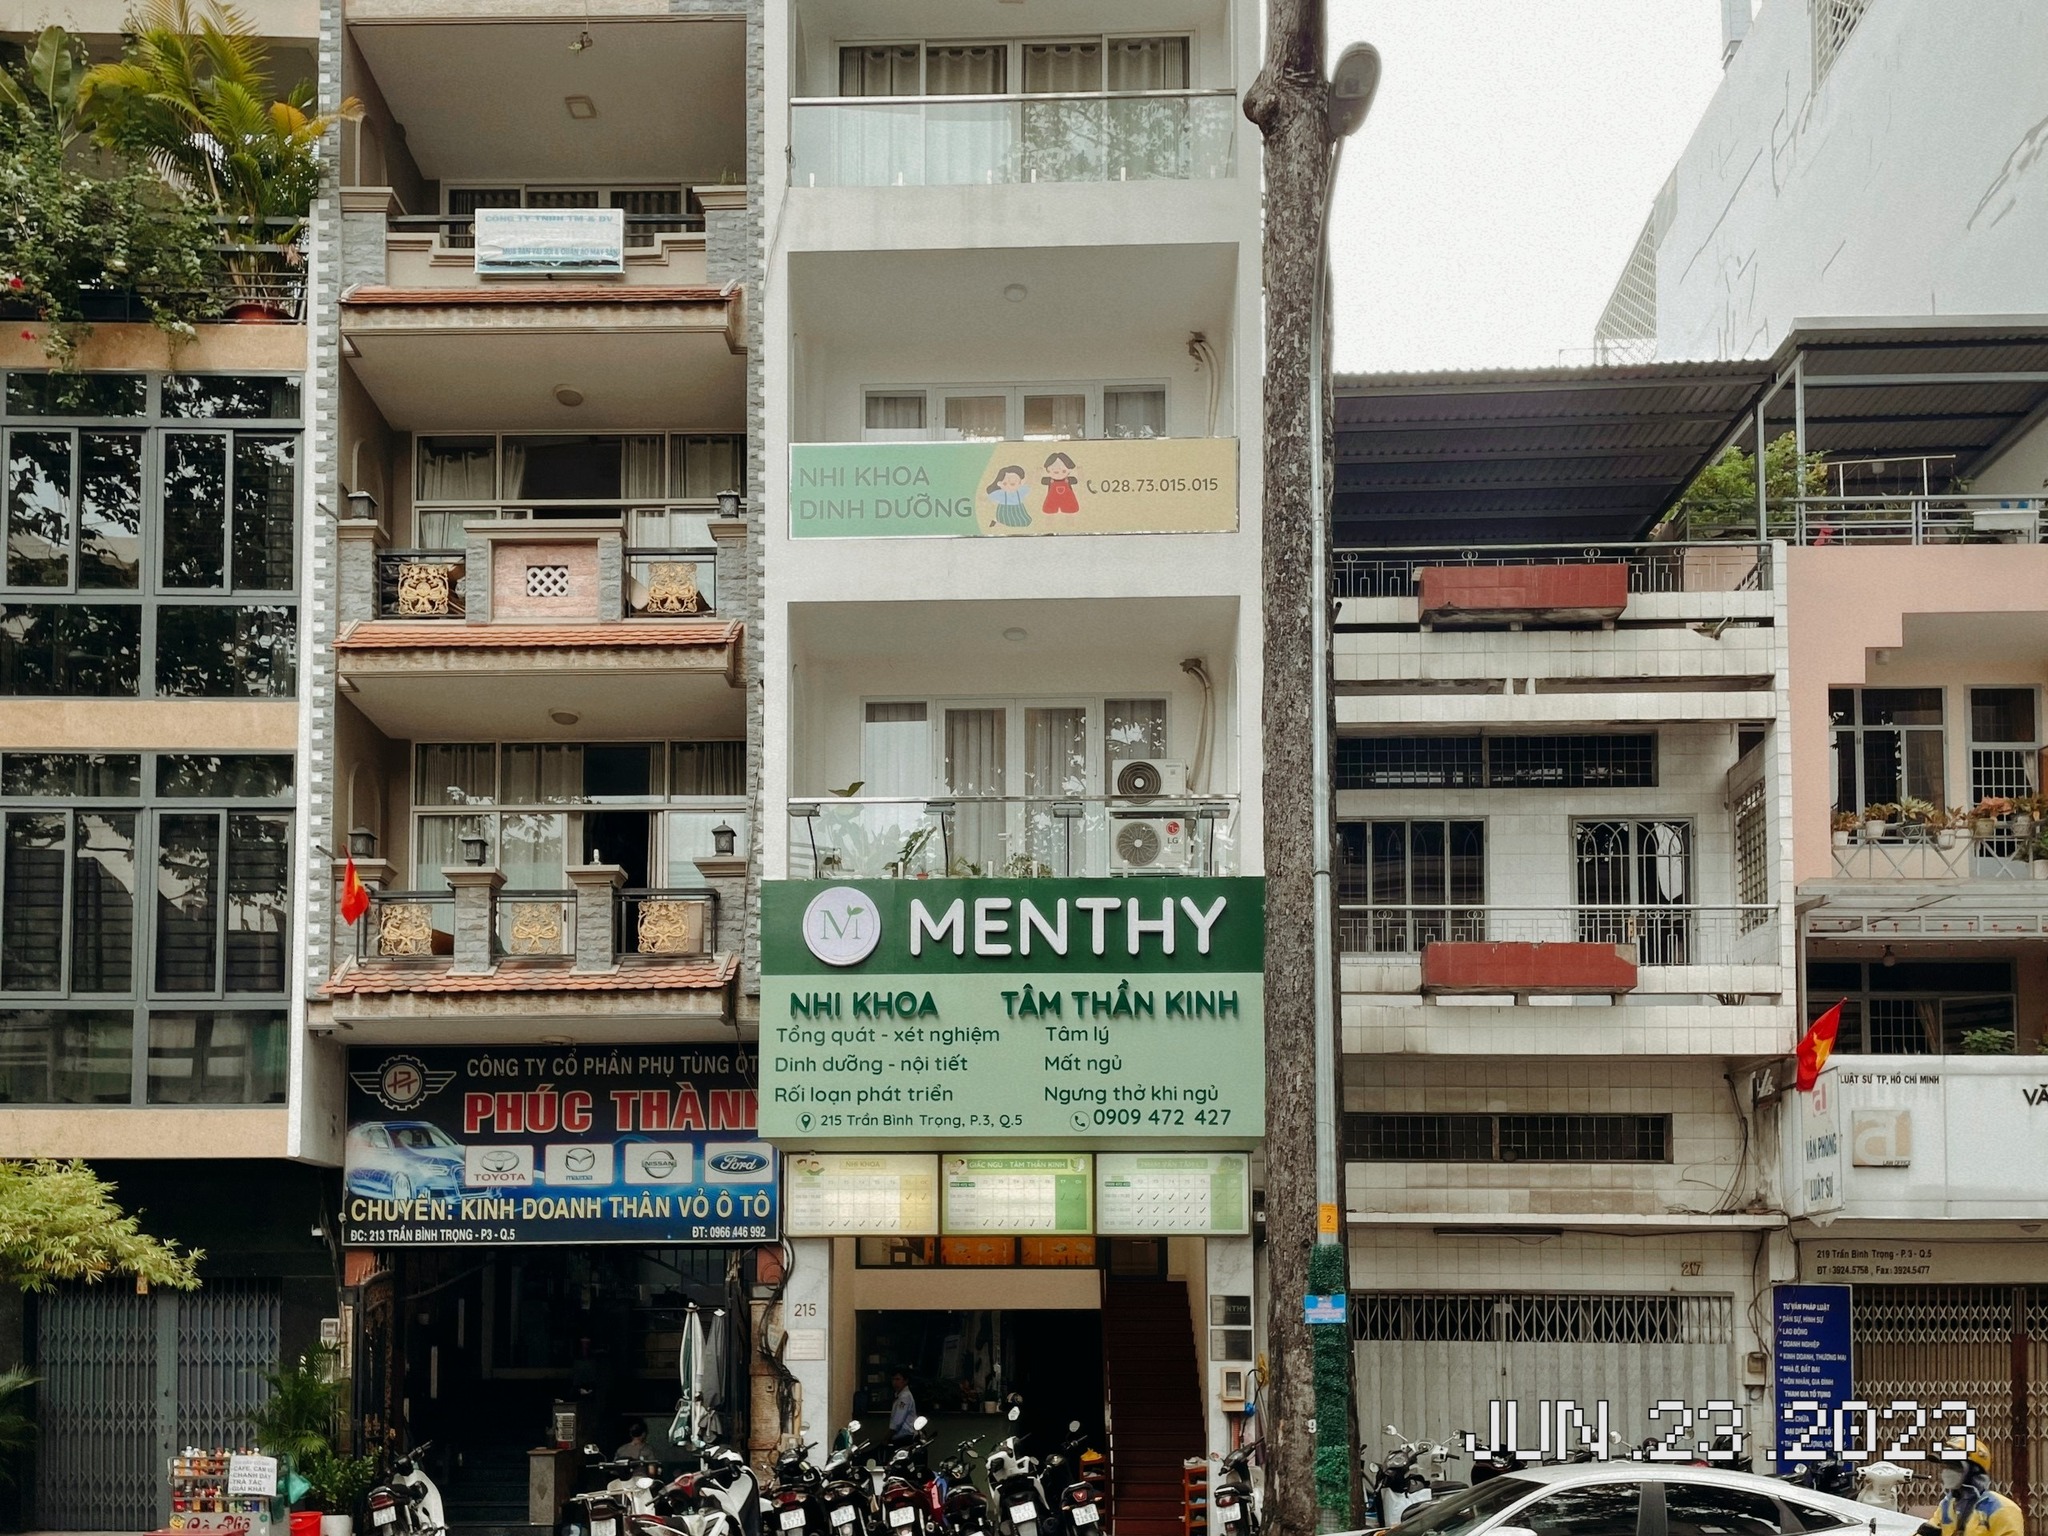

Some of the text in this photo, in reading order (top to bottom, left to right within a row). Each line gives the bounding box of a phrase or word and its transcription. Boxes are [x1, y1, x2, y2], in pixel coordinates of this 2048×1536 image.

[800, 466, 930, 488] NHI KHOA
[1100, 478, 1218, 494] 028.73.015.015
[800, 494, 973, 520] DINH DƯỠNG
[1167, 837, 1179, 845] LG
[909, 896, 1228, 956] MENTHY
[790, 991, 939, 1018] NHI KHOA
[1000, 978, 1238, 1017] TÂM THẦN KINH
[776, 1025, 1000, 1046] Tổng quát xét nghiệm
[1046, 1025, 1110, 1045] Tâm lý
[466, 1054, 519, 1077] CÔNG
[524, 1057, 547, 1077] TY
[552, 1047, 578, 1077] CỔ
[583, 1048, 632, 1076] PHẦN
[638, 1055, 676, 1078] PHỤ
[680, 1051, 730, 1074] TÙNG
[775, 1054, 968, 1075] Dinh dưỡng nội tiết
[1044, 1054, 1122, 1075] Mất ngủ
[1840, 1072, 1859, 1086] LUẬT
[1862, 1073, 1874, 1084] SƯ
[1890, 1071, 1902, 1084] HỒ
[1904, 1072, 1918, 1084] CHÍ
[1919, 1075, 1940, 1085] MINH
[775, 1084, 953, 1105] Rối loạn phát triển
[1044, 1084, 1219, 1105] Ngưng thở khi ngủ
[463, 1083, 593, 1133] PHÚC
[1093, 1108, 1232, 1125] 0909 472 427
[820, 1112, 1023, 1129] 215 Trần Bình Trọng, P.3, Q.5
[720, 1154, 758, 1172] Ford
[473, 1173, 526, 1182] TOYOTA
[351, 1187, 771, 1222] CHUYÊN: KINH DOANH THÂN VỎ Ô TÔ
[350, 1224, 516, 1243] ĐC: 213 TRẦN BÌNH TRỌNG P3 Q.5
[692, 1225, 767, 1239] ĐT: 0966 446 992
[1816, 1249, 1830, 1259] 219
[1871, 1249, 1894, 1261] Trọng
[1918, 1249, 1932, 1259] Q.5
[1681, 1261, 1703, 1277] 217
[794, 1303, 817, 1317] 215
[1802, 1302, 1816, 1311] PHÁP
[1817, 1302, 1830, 1312] LUẬT
[1782, 1340, 1801, 1348] DOANH
[1784, 1390, 1800, 1398] THAM
[1800, 1390, 1809, 1398] GIA
